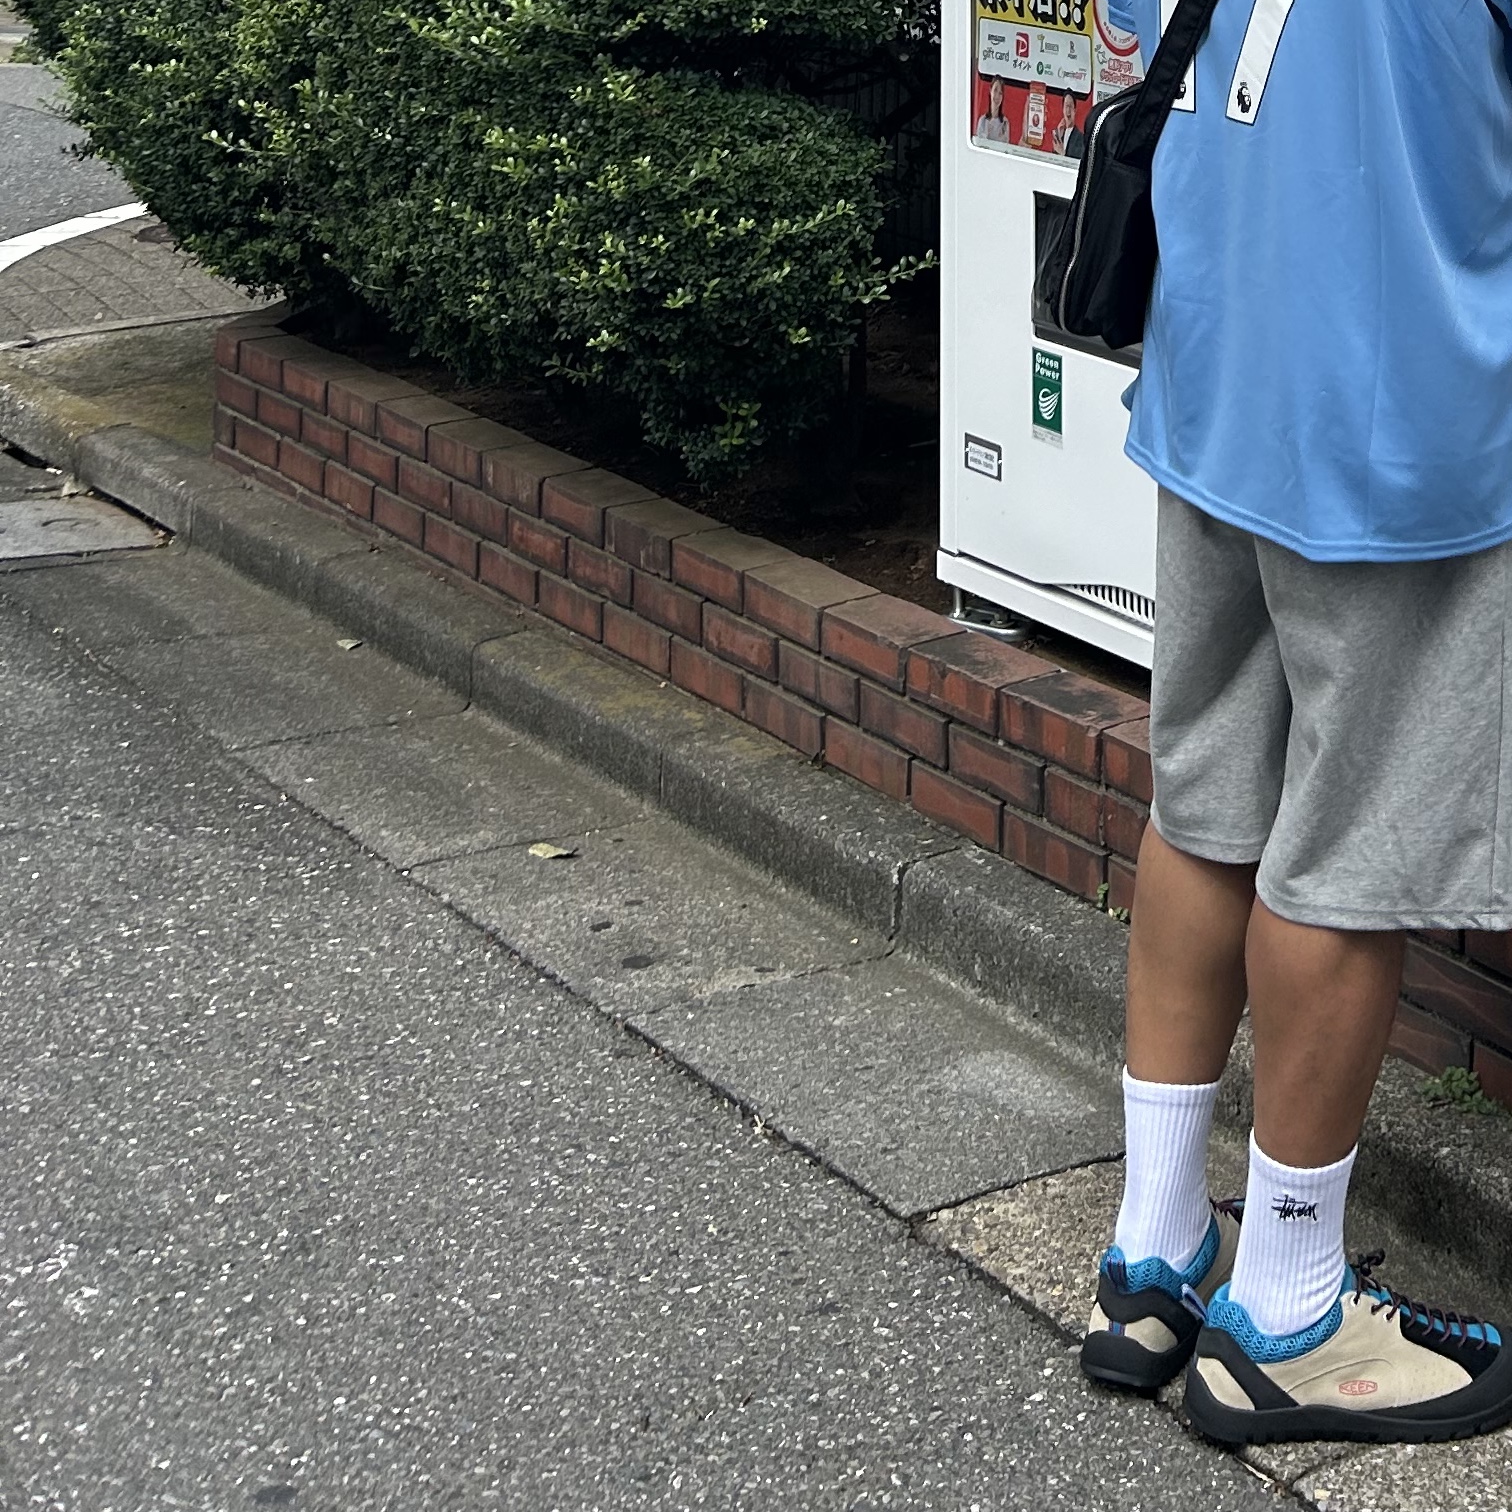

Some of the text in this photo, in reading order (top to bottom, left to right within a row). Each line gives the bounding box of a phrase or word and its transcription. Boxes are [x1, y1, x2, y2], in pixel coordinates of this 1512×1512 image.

[983, 46, 1010, 62] gift card
[1035, 351, 1060, 370] Green
[1034, 361, 1061, 381] Power
[1341, 1382, 1377, 1396] KEEN
